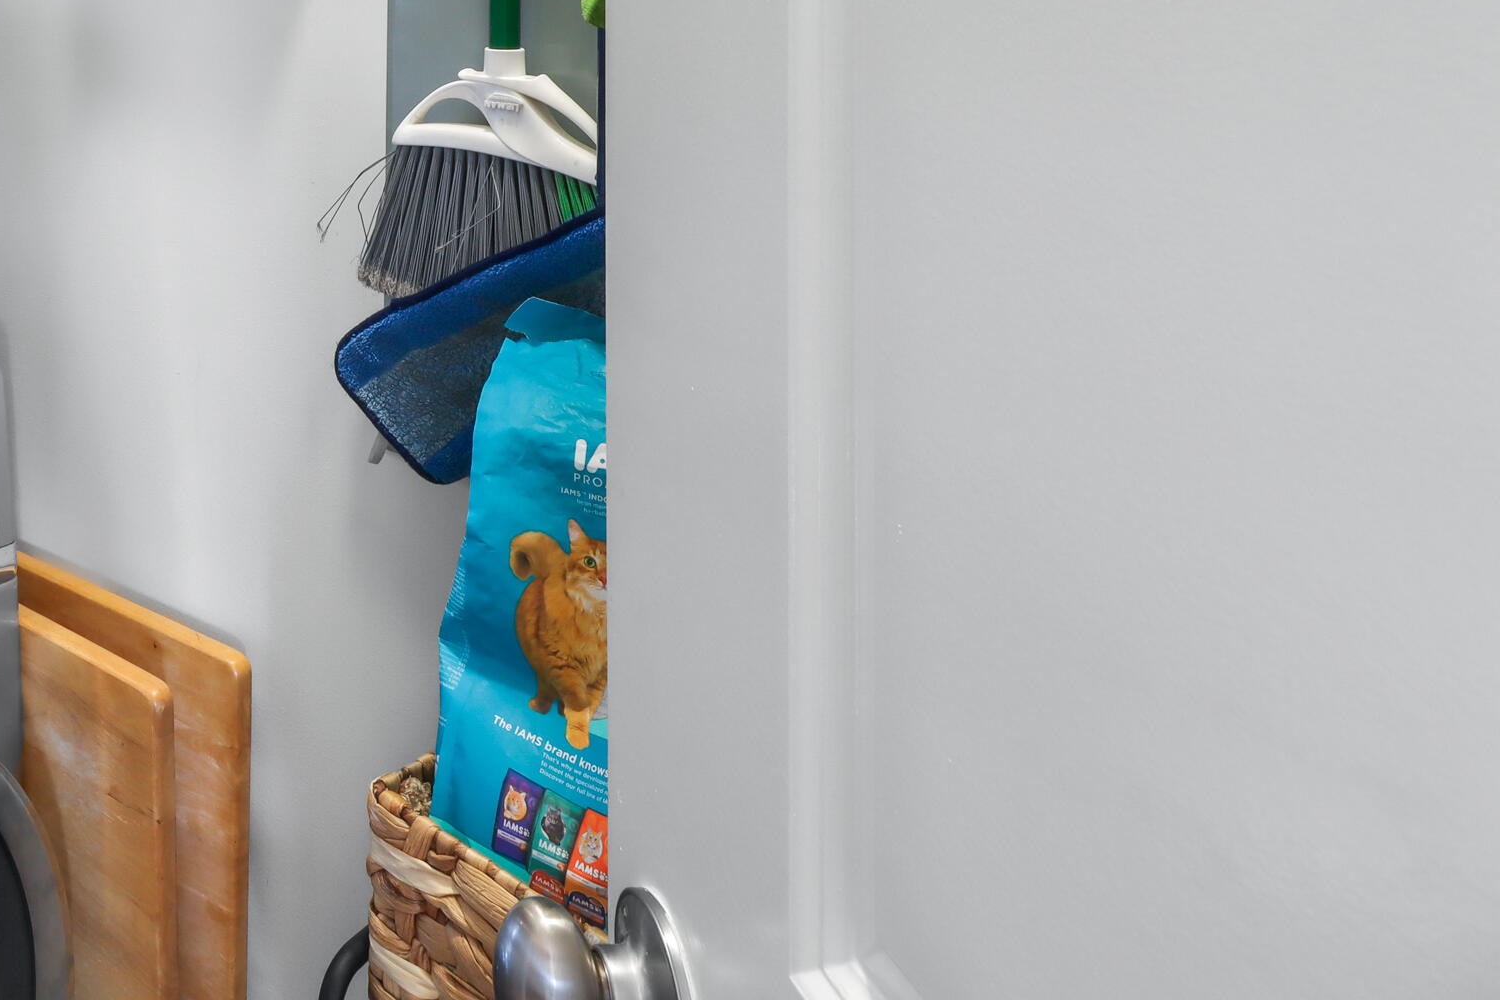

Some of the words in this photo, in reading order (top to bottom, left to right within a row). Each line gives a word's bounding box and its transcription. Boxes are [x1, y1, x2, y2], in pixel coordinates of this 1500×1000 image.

[573, 472, 607, 489] PRO
[493, 714, 513, 732] The
[514, 725, 543, 747] IAMS
[544, 741, 578, 764] brand
[578, 756, 609, 779] knows
[539, 767, 565, 785] Discover
[565, 781, 576, 791] our
[576, 786, 586, 796] full
[503, 818, 523, 834] IAMS
[538, 839, 562, 856] IAMS
[574, 859, 599, 879] IAMS
